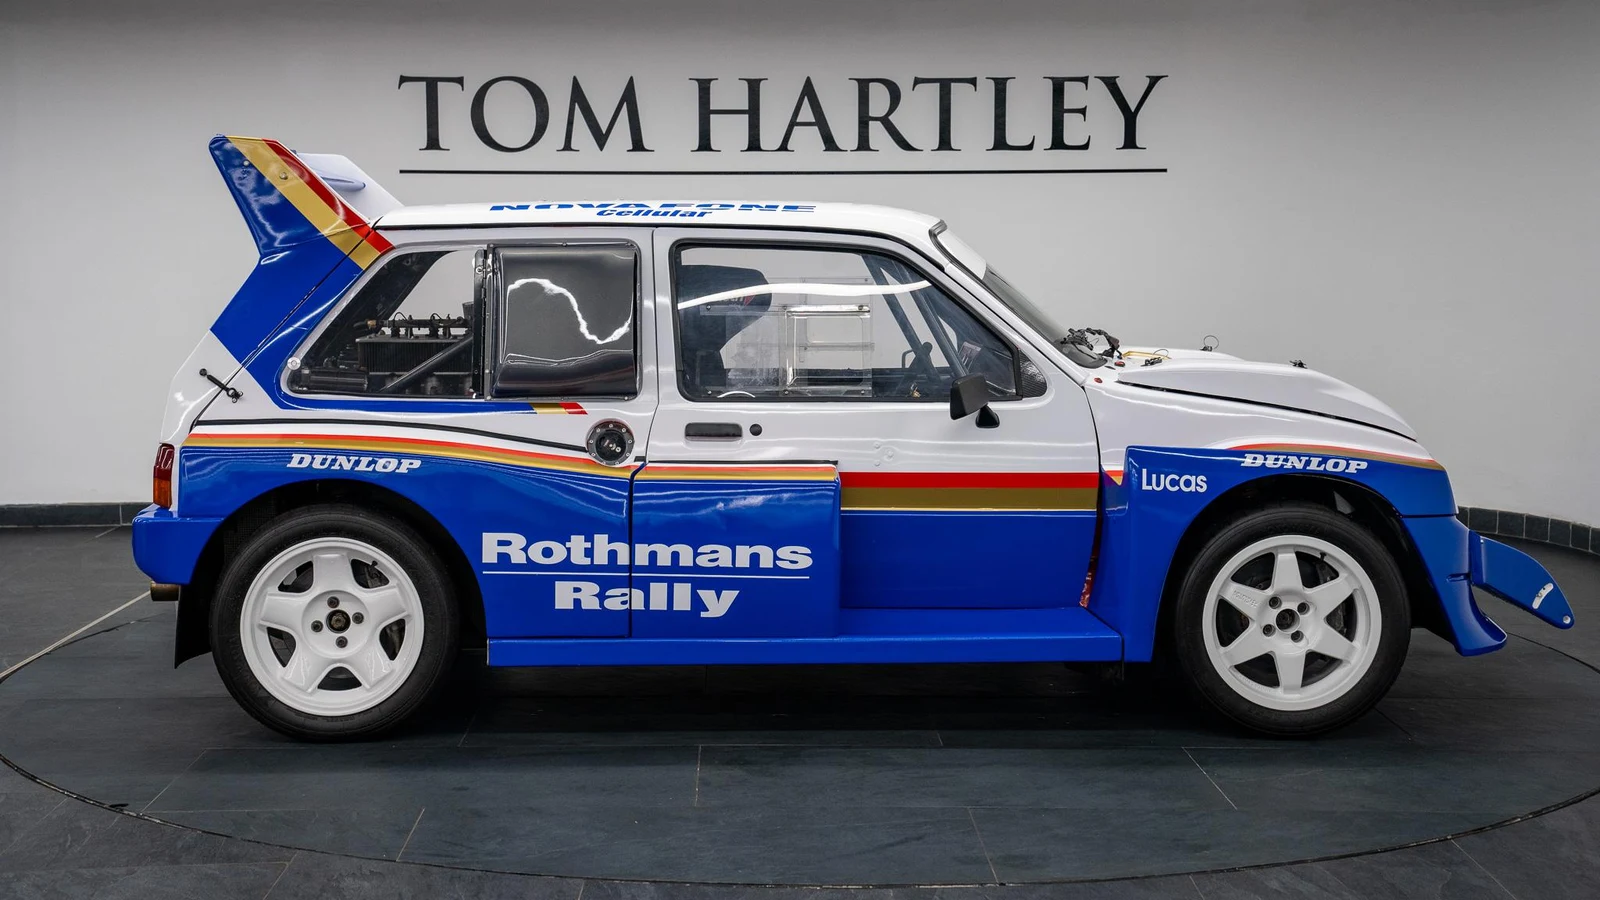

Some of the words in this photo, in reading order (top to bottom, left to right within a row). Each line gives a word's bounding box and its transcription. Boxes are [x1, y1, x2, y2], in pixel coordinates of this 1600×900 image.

[398, 75, 654, 153] TOM
[689, 75, 1168, 152] HARTLEY
[490, 203, 816, 213] NOVAFONE
[597, 209, 712, 218] Cellular
[286, 453, 422, 473] DUNLOP
[1241, 453, 1368, 473] DUNLOP
[1142, 468, 1208, 493] Lucas
[482, 532, 813, 569] Rothmans
[554, 581, 739, 618] Rally
